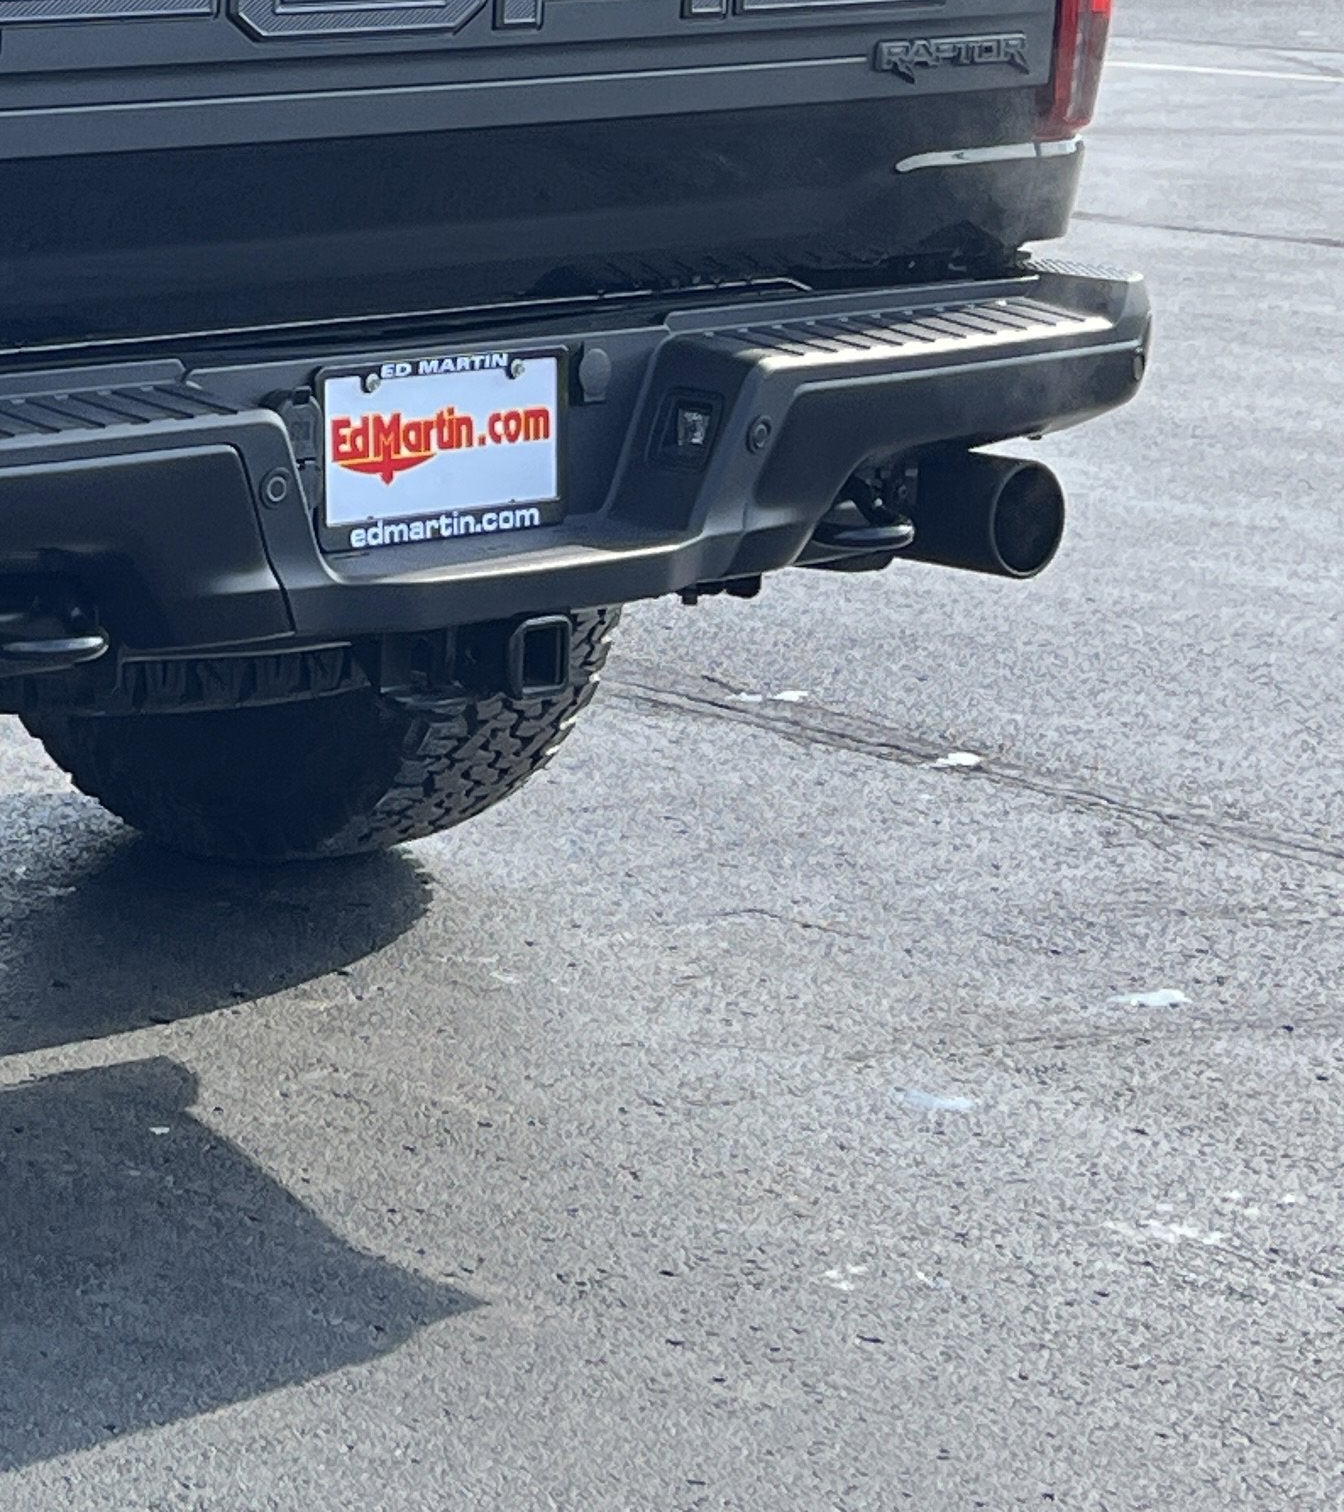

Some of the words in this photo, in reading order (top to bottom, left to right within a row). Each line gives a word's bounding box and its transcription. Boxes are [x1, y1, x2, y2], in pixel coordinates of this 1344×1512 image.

[872, 31, 1030, 84] RAPTOR
[381, 363, 412, 379] ED
[418, 353, 509, 376] MARTIN
[350, 506, 540, 548] edmartin.com
